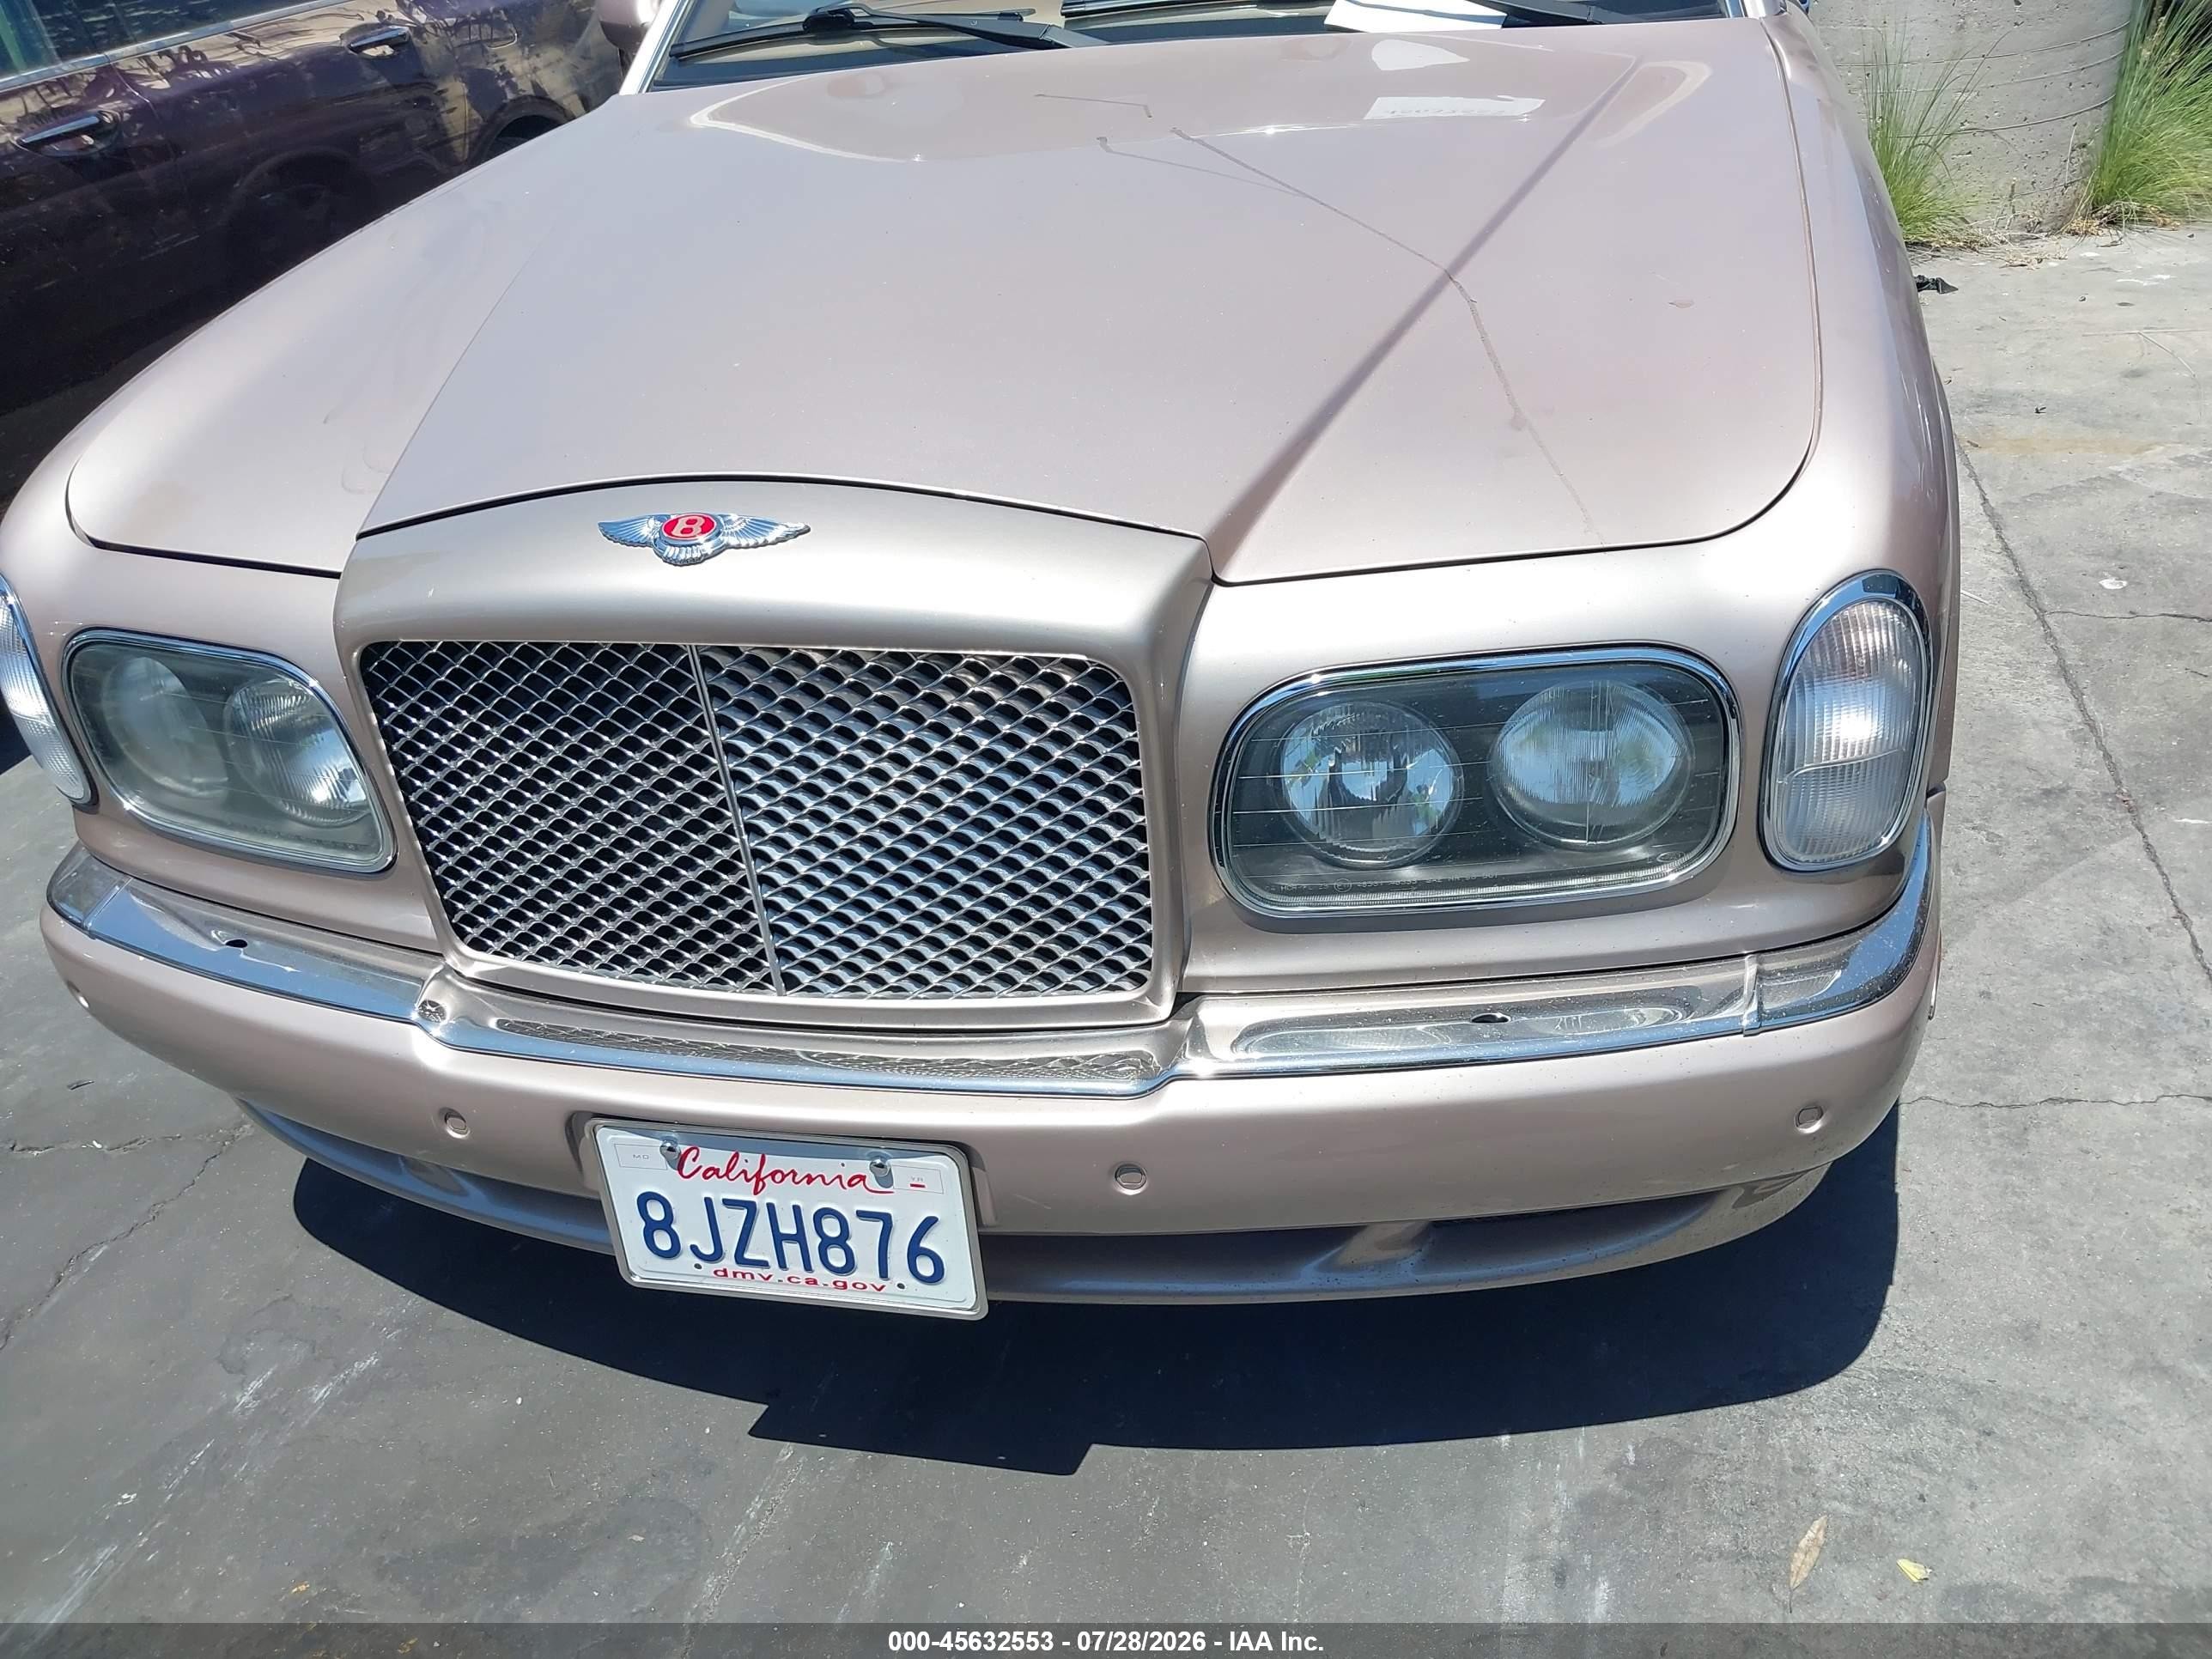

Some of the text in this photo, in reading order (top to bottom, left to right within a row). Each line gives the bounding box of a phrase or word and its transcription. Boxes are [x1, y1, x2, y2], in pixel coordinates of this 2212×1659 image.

[672, 515, 705, 538] B
[677, 1146, 895, 1195] California
[636, 1191, 945, 1283] 8JZH876
[713, 1267, 887, 1292] dmv.ca.gov
